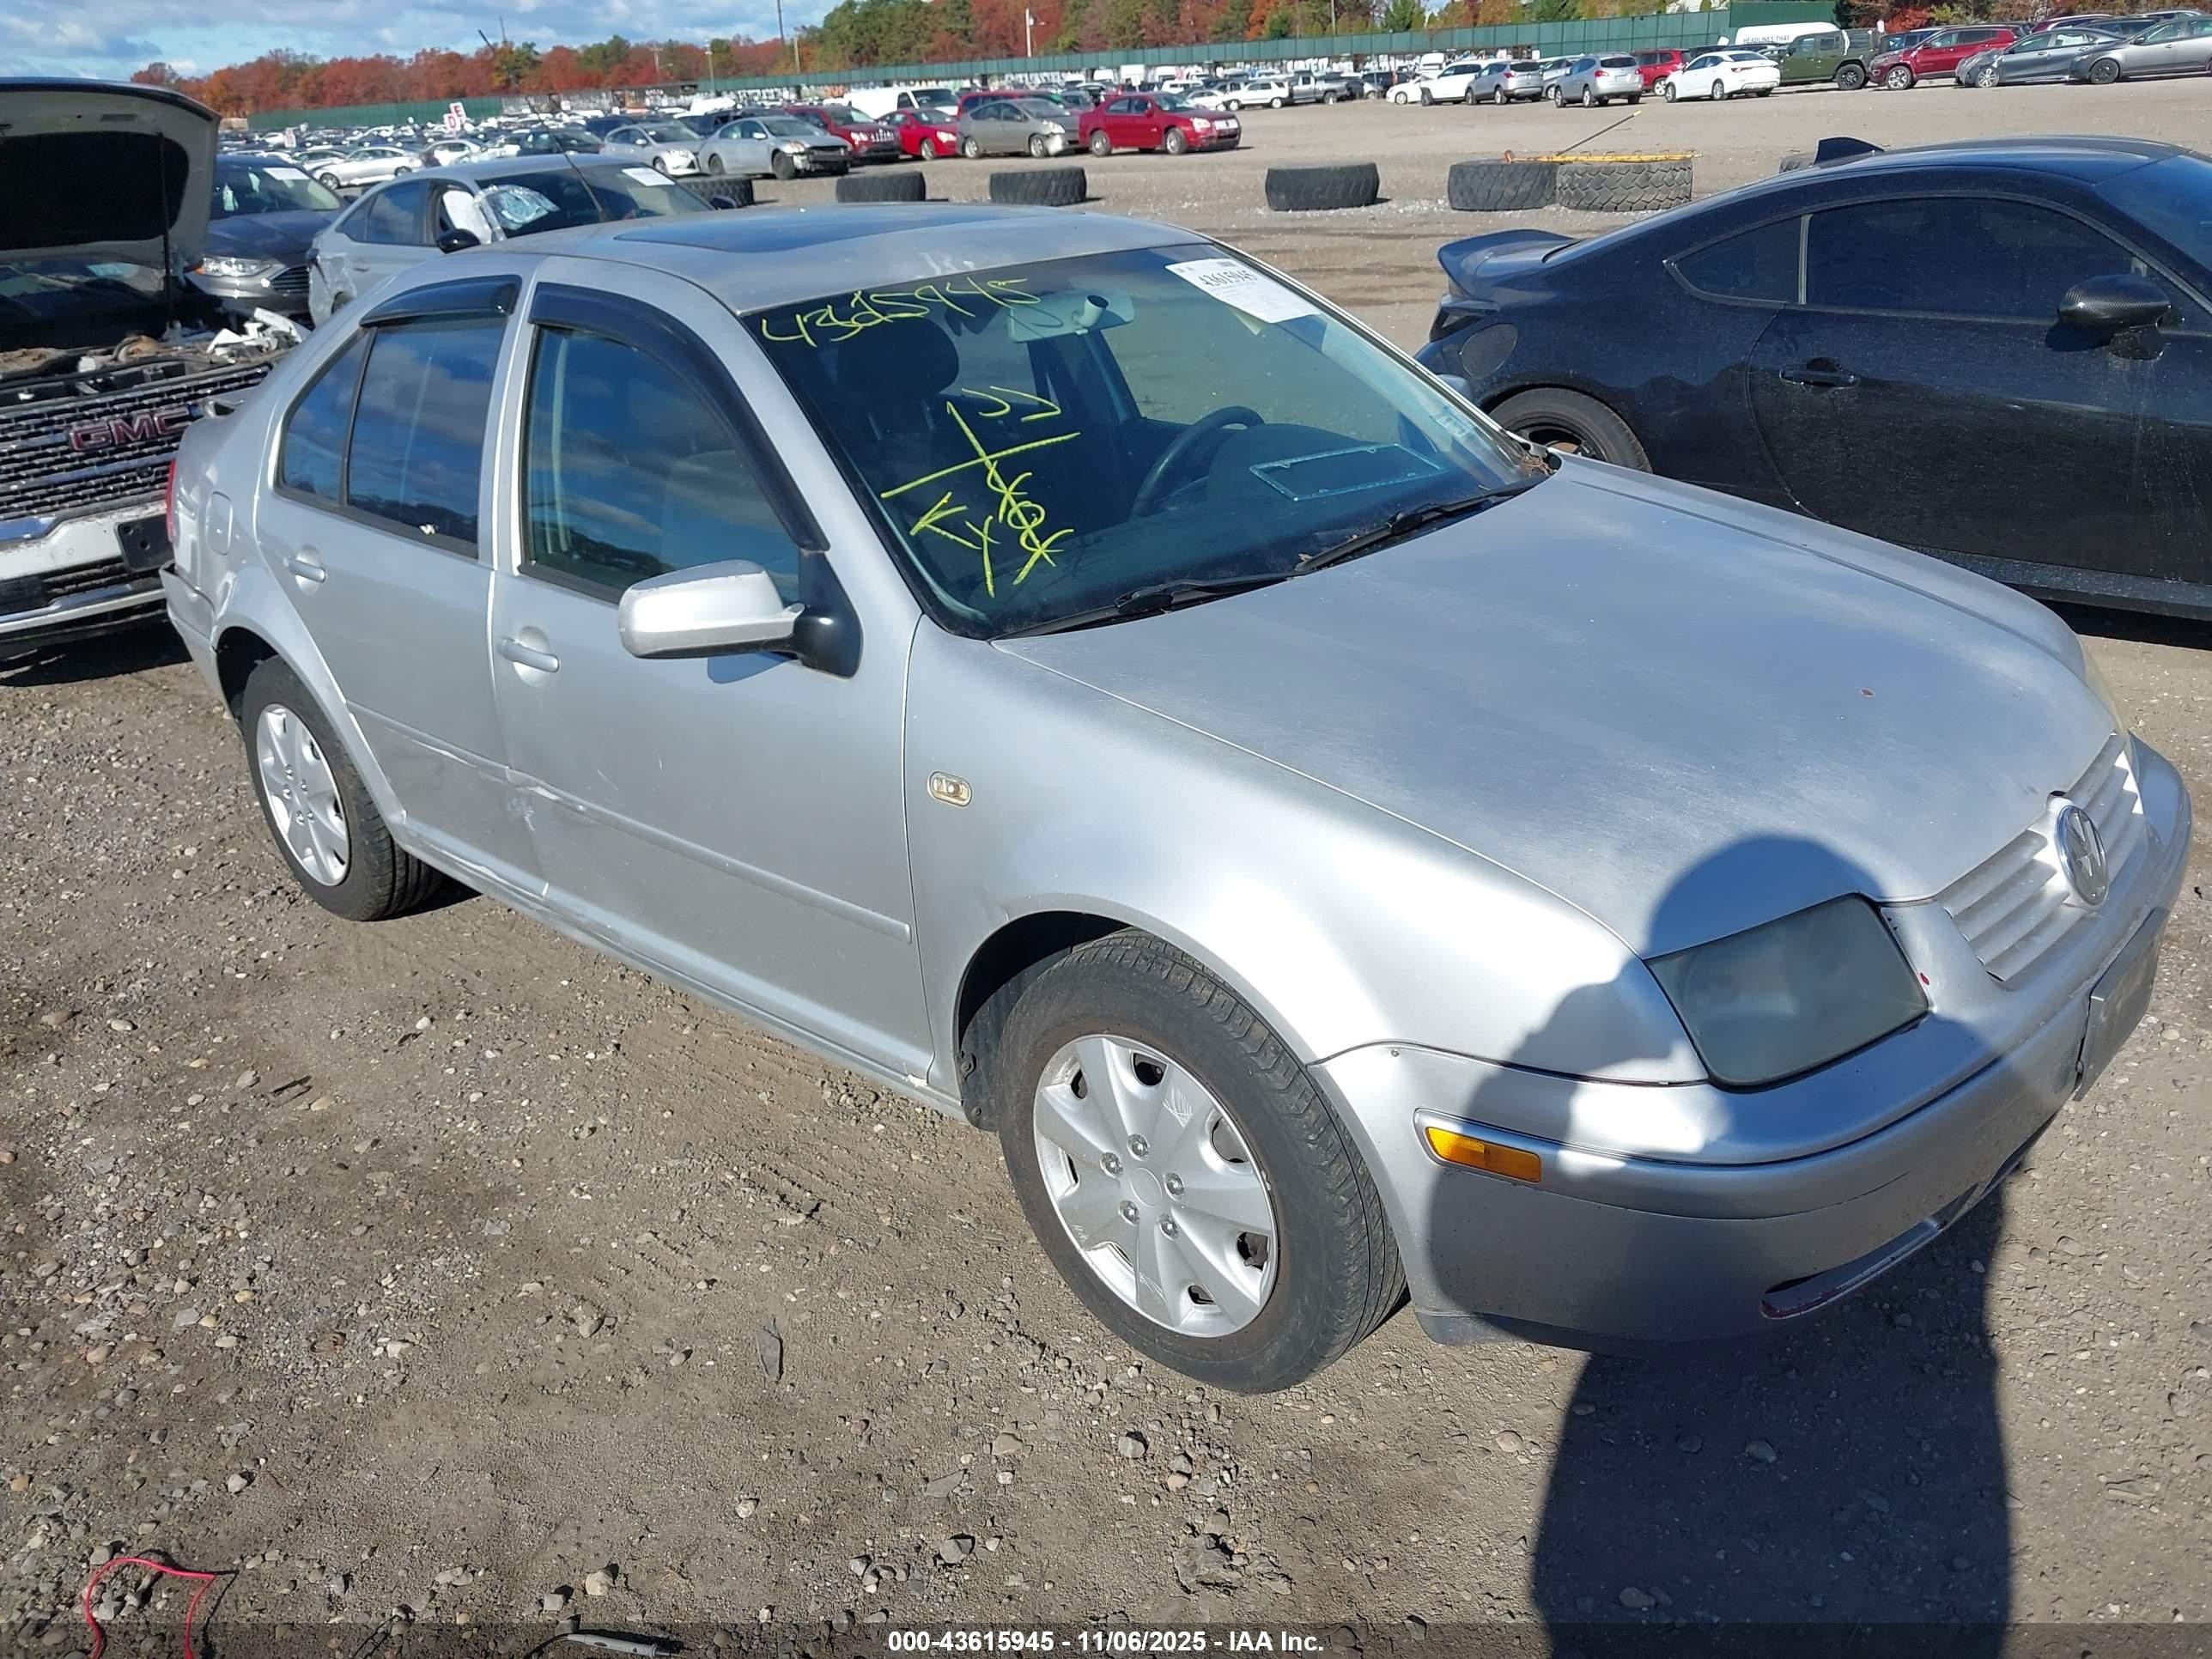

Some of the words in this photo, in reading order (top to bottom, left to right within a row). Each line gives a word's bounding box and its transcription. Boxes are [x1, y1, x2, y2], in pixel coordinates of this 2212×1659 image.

[453, 105, 463, 118] E
[447, 116, 457, 128] D
[70, 404, 189, 452] GMC
